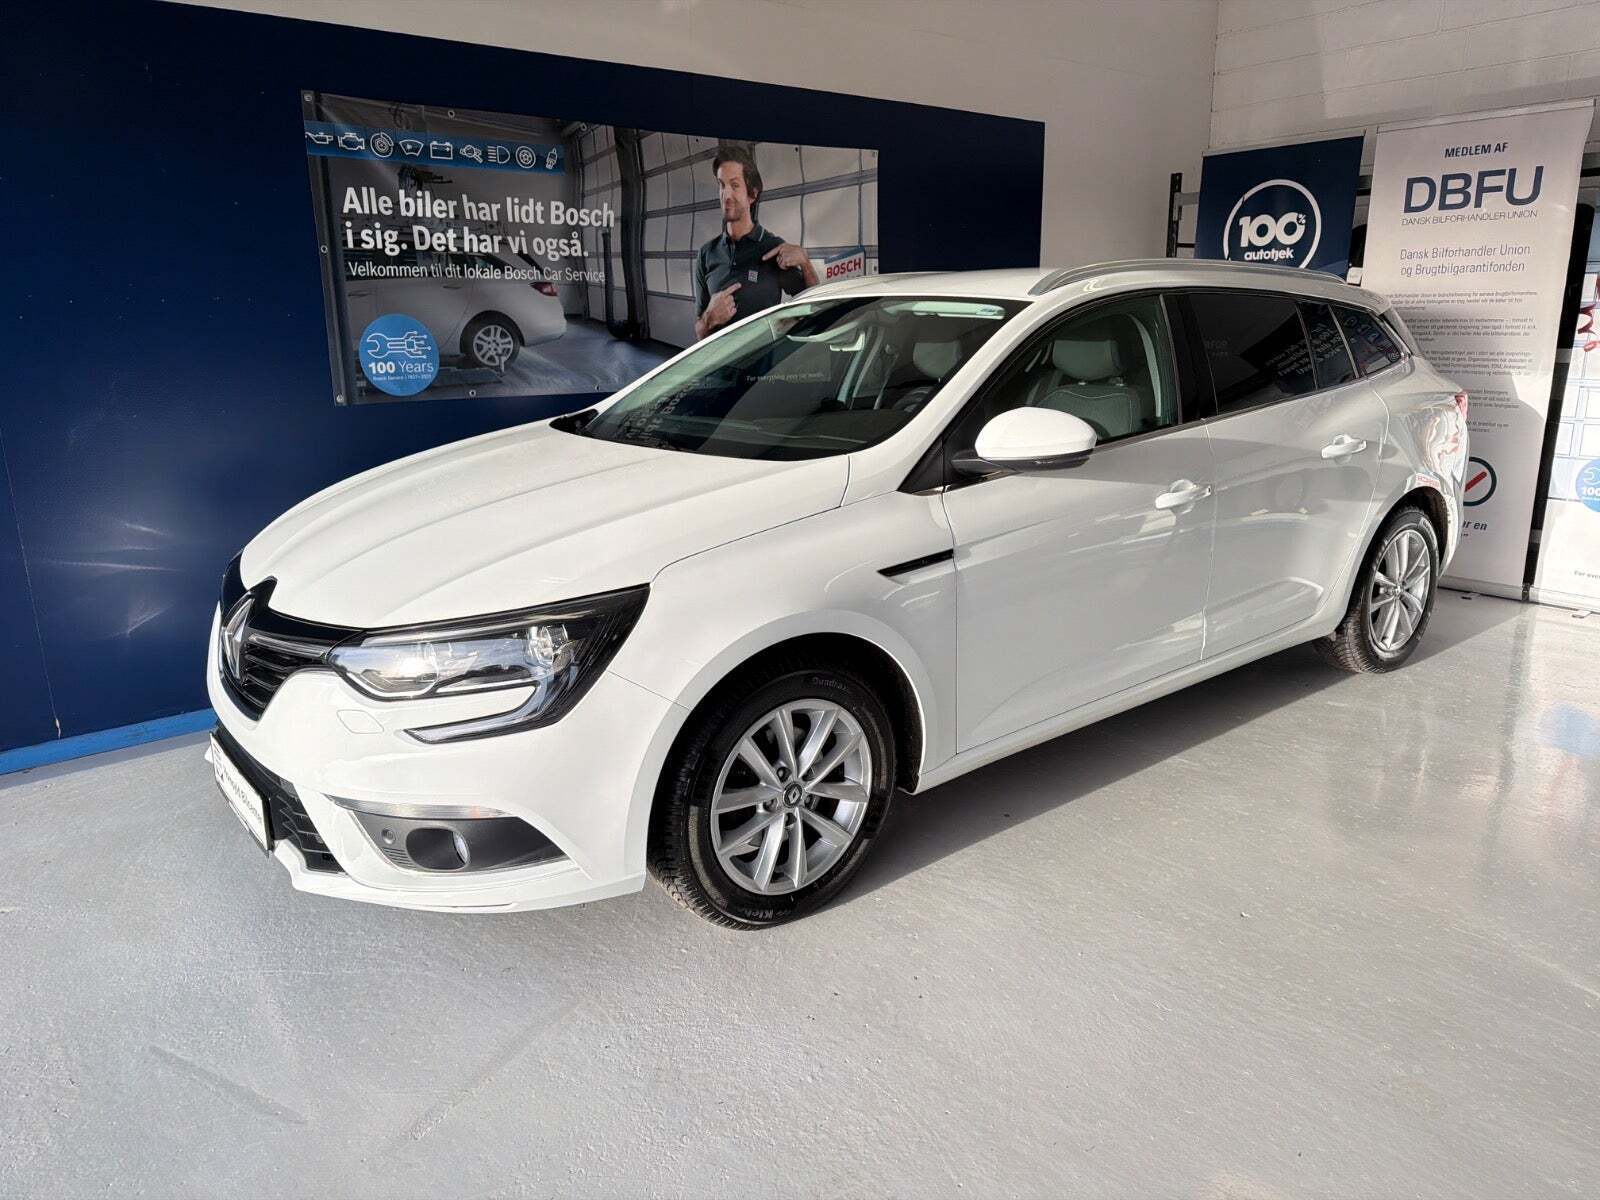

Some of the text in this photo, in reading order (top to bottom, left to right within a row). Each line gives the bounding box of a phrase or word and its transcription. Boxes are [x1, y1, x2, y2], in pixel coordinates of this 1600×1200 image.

[1444, 142, 1509, 159] MEDLEM AF
[1403, 165, 1545, 214] DBFU
[342, 186, 614, 227] Alle biler har lidt Bosch
[1401, 209, 1538, 226] DANSK BILFORHANDLER UNION
[344, 220, 589, 261] i sig. Det har vi også.
[1400, 243, 1531, 261] Dansk Bilforhandler Union
[348, 261, 605, 282] Velkommen til dit lokale Bosch Car Service
[826, 258, 862, 279] BOSCH
[1400, 260, 1526, 277] og Brugtbilgarantifonden
[368, 360, 434, 375] 100 Years
[1474, 522, 1488, 531] en
